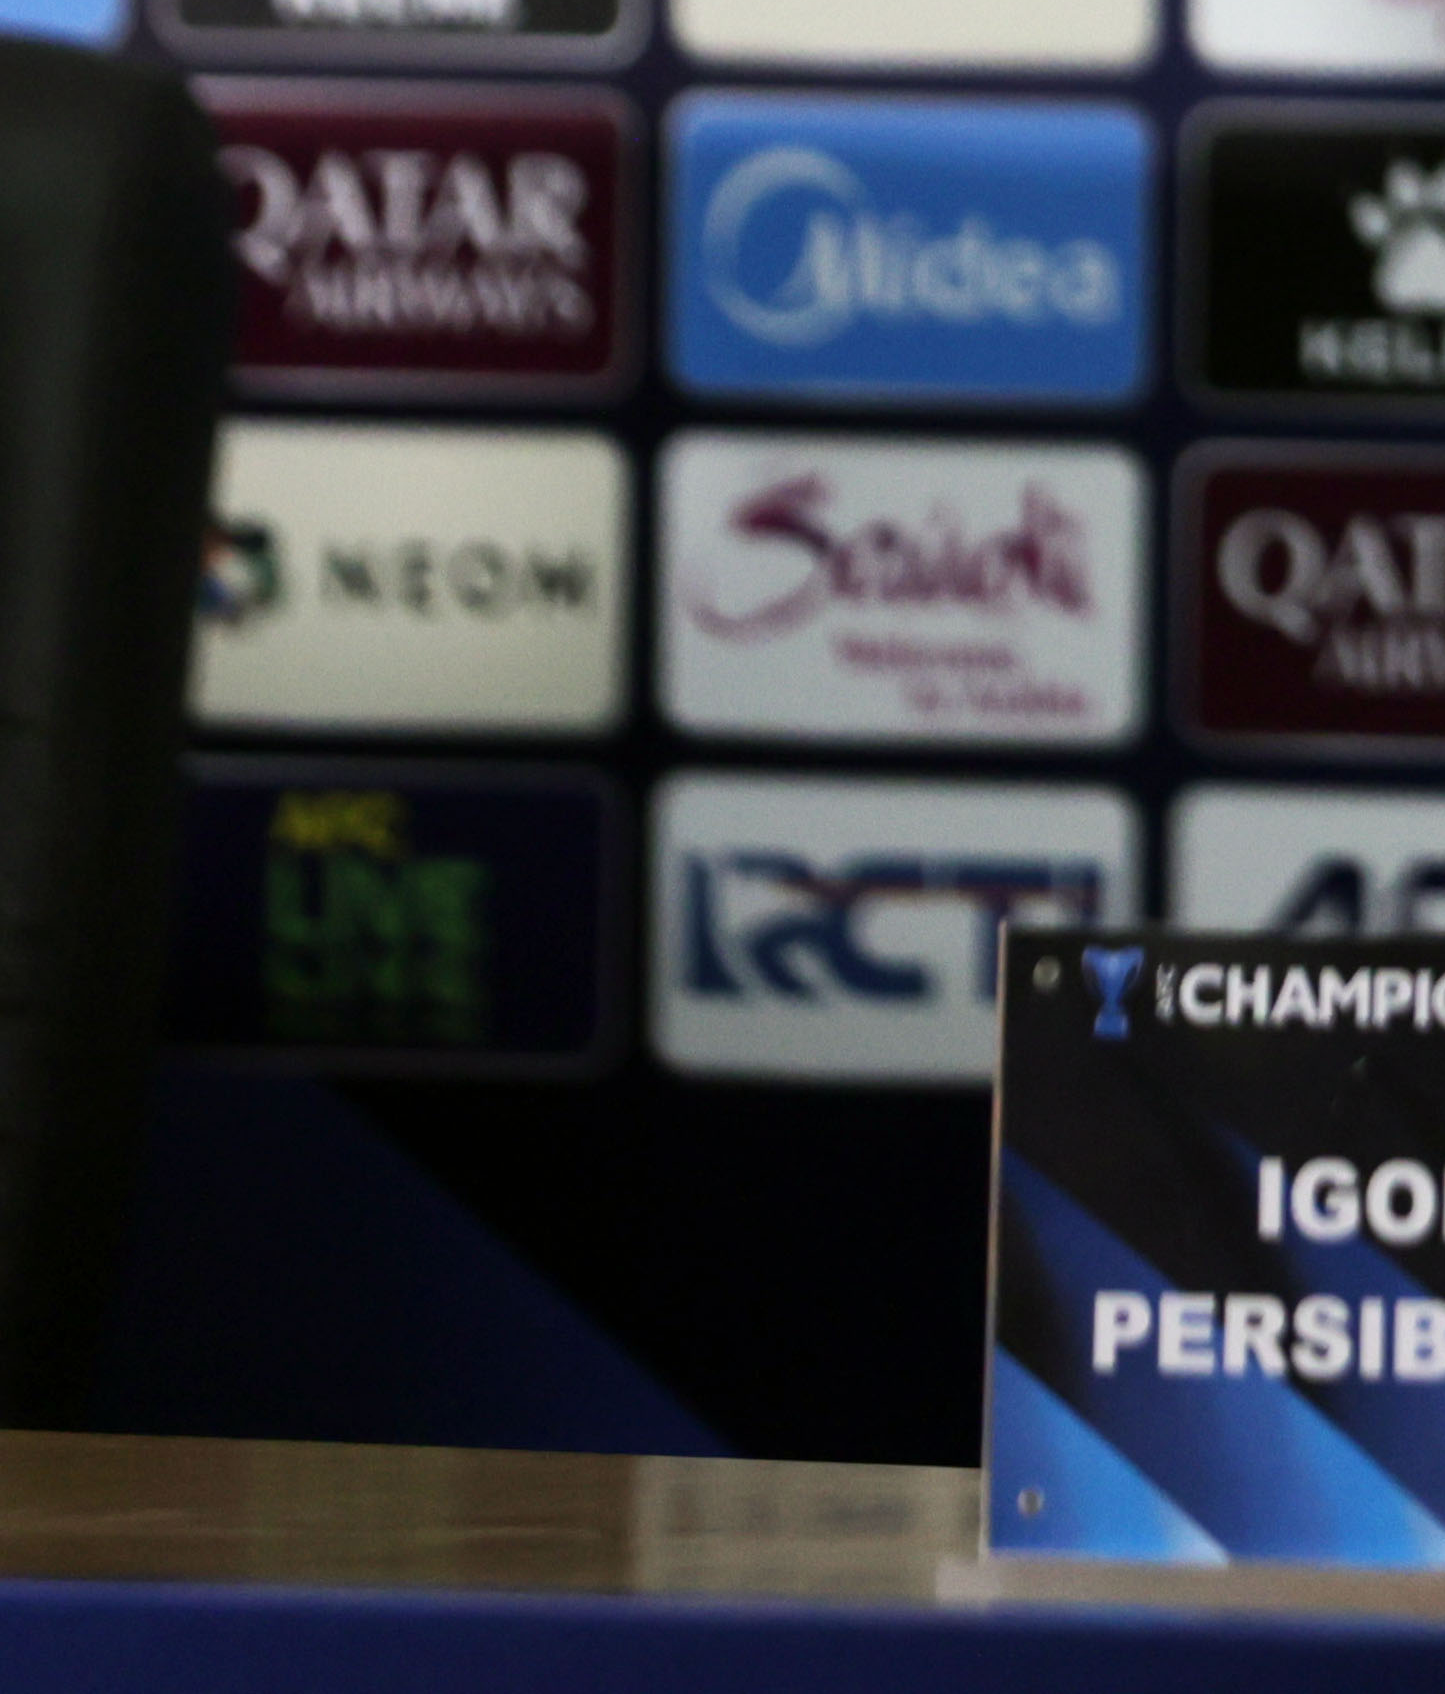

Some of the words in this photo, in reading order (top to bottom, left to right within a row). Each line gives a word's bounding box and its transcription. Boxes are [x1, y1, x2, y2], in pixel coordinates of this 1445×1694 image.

[217, 145, 588, 286] QATAR
[775, 211, 1122, 326] Midea
[321, 548, 591, 619] NEOM
